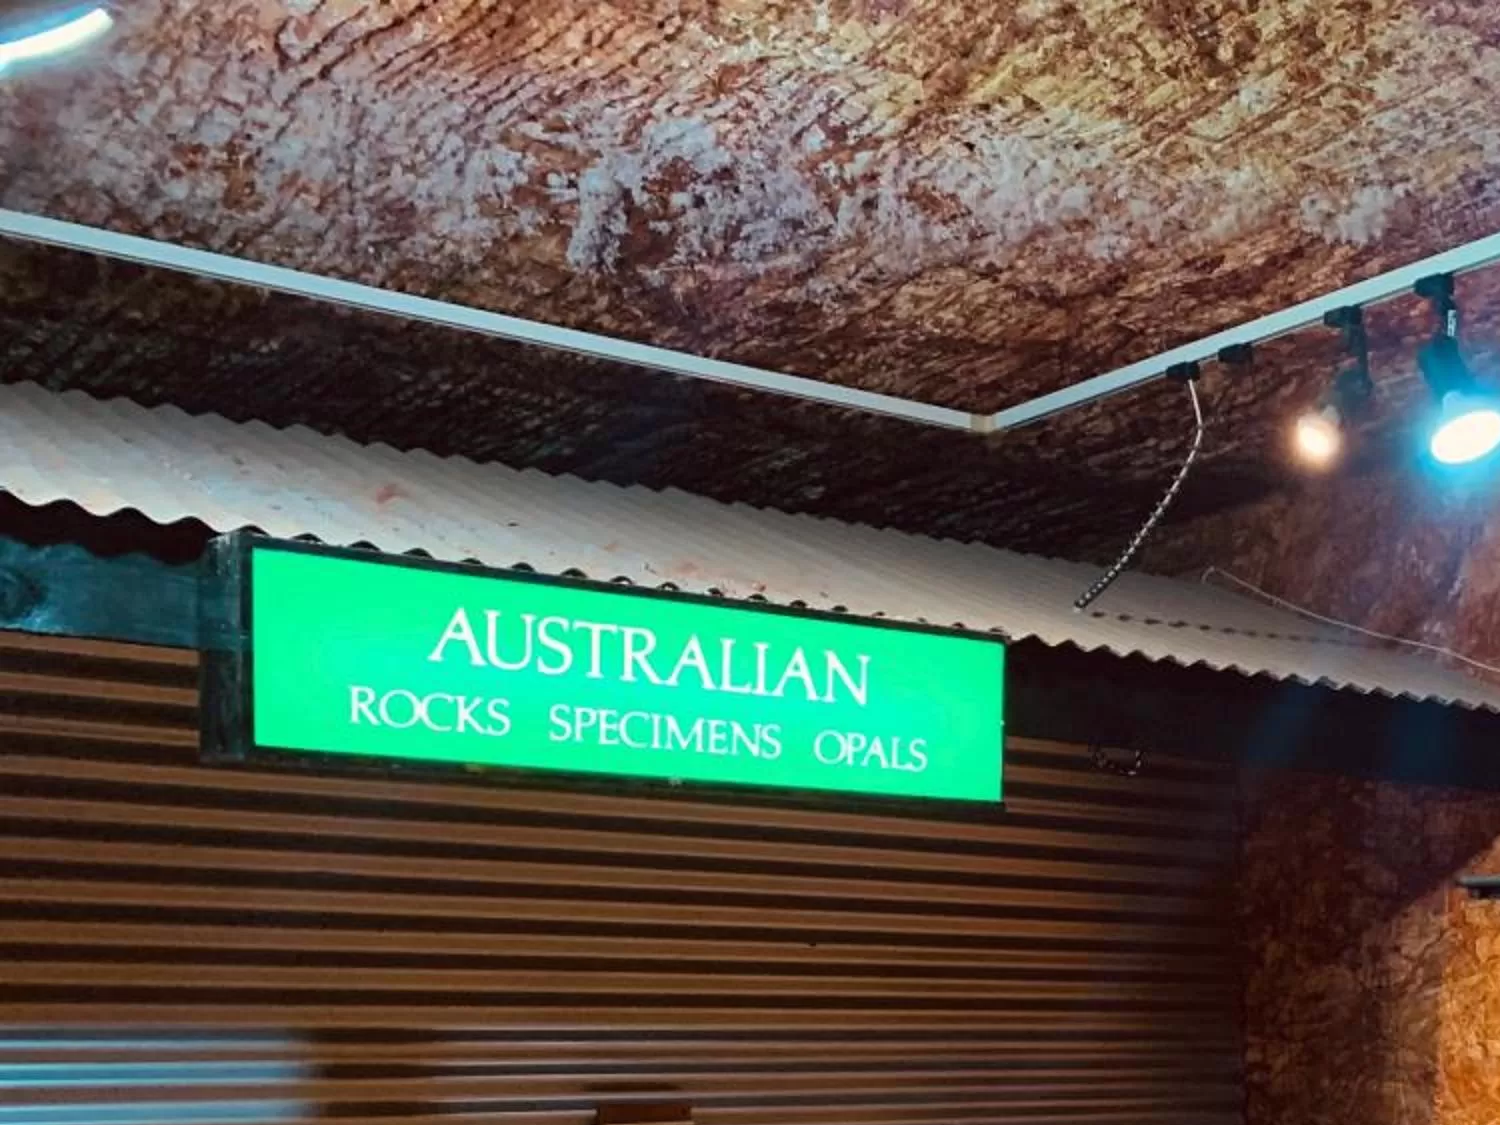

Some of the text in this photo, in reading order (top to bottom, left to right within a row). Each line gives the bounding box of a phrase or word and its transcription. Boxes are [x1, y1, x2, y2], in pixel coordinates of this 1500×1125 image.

[428, 607, 871, 705] AUSTRALIAN
[349, 685, 928, 772] ROCKS SPECIMENS OPALS
